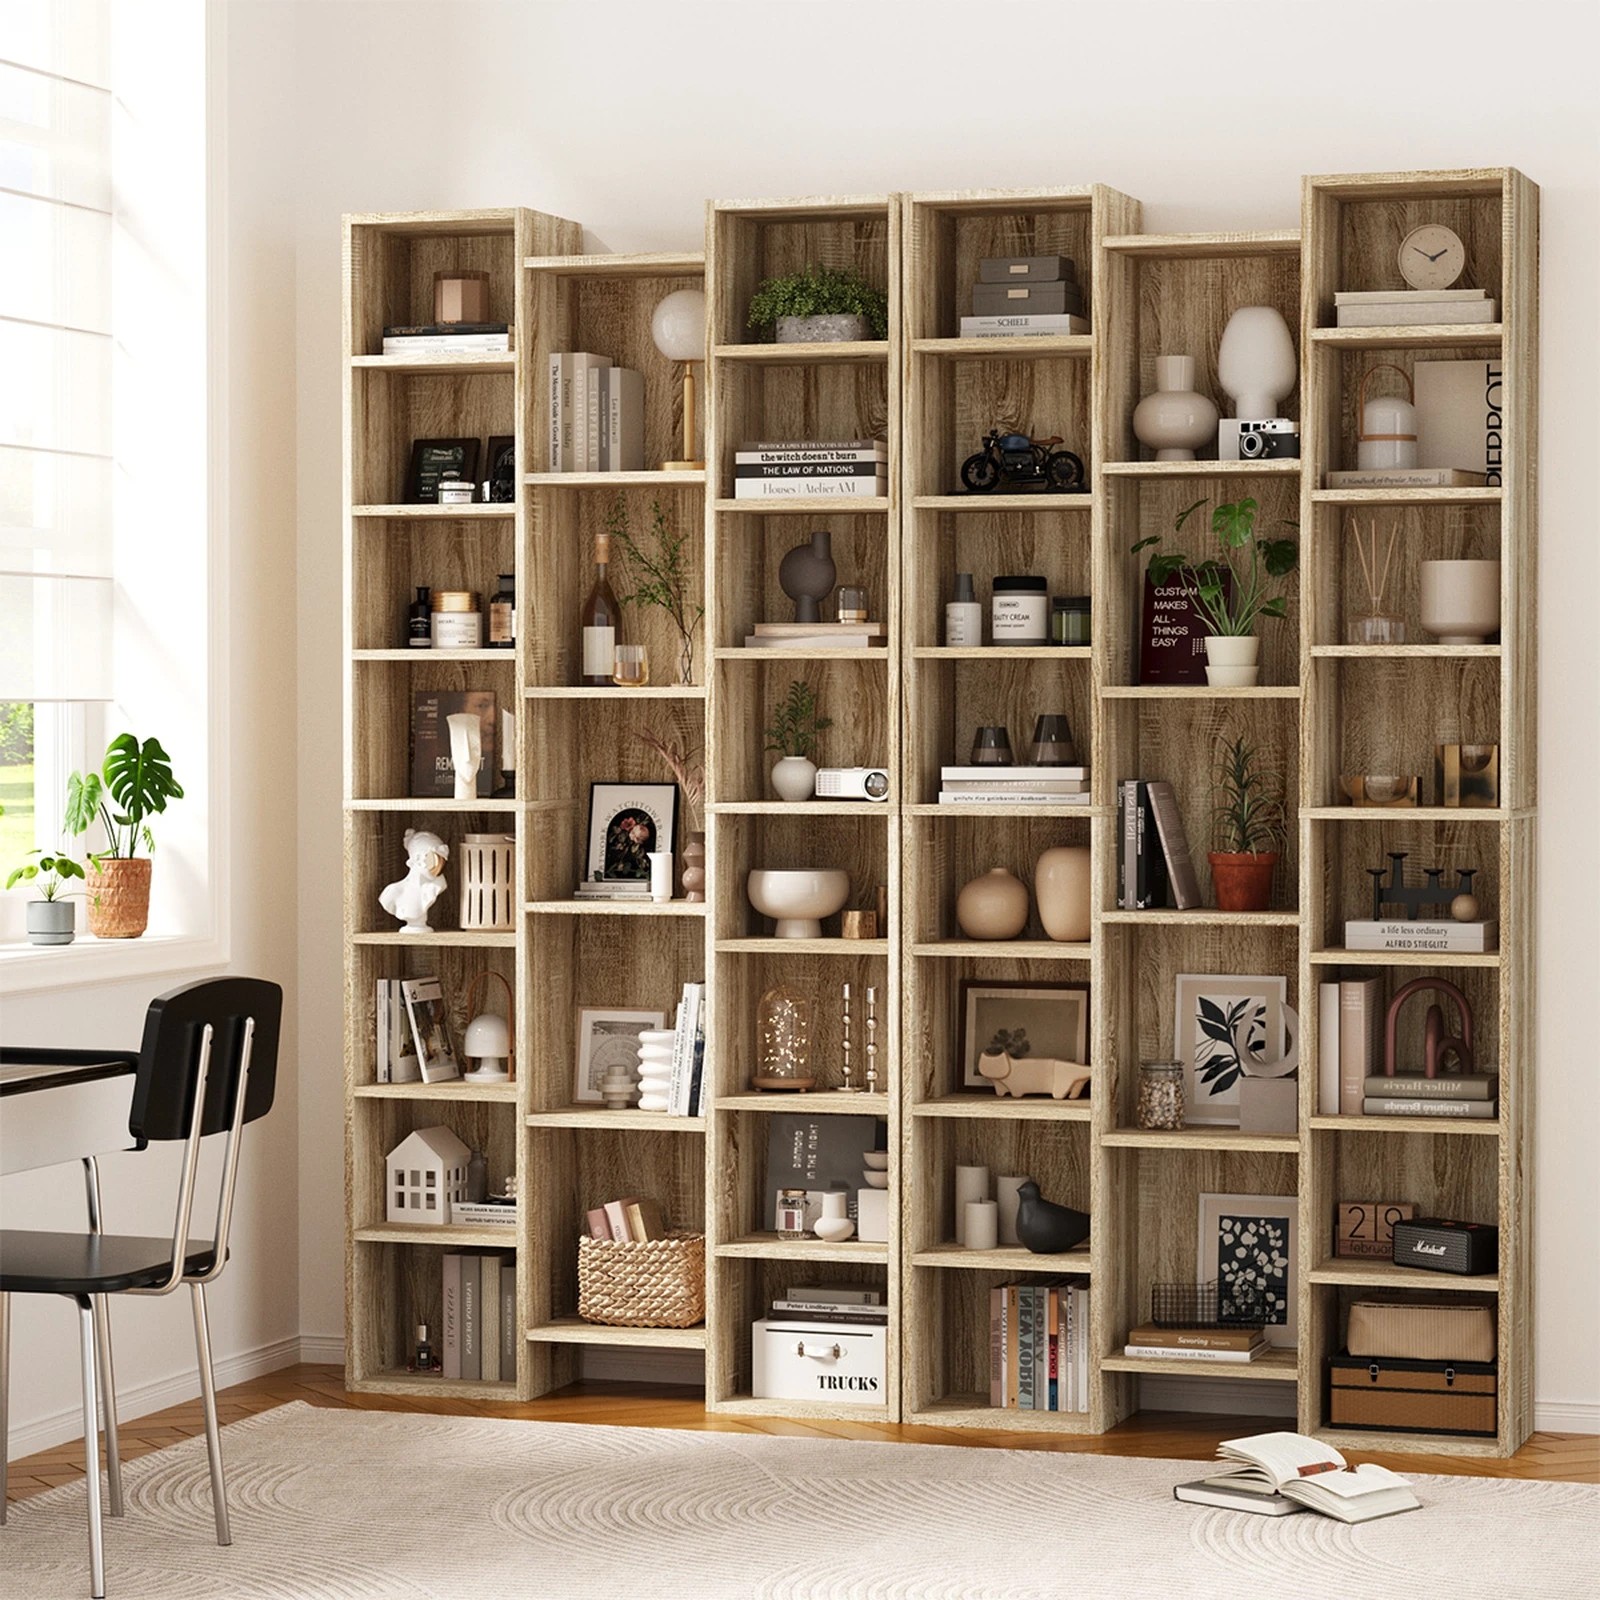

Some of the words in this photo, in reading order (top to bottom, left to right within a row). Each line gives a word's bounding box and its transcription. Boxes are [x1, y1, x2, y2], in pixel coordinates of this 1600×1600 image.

[997, 318, 1030, 327] SCHIELE
[761, 453, 775, 461] the
[776, 452, 800, 461] witch
[802, 451, 834, 460] doesn't
[836, 451, 857, 460] burn
[762, 466, 780, 475] THE
[782, 466, 801, 474] LAW
[802, 466, 814, 474] OF
[816, 465, 854, 474] NATIONS
[763, 483, 796, 494] Houses
[802, 482, 835, 494] Atelier
[839, 482, 856, 493] AM
[1153, 601, 1188, 610] MAKES
[1152, 615, 1170, 624] ALL
[1152, 626, 1189, 636] THINGS
[1151, 638, 1178, 647] EASY
[1387, 926, 1399, 934] life
[1401, 926, 1414, 935] less
[1416, 926, 1448, 936] ordinary
[1385, 940, 1412, 948] ALFRED
[1414, 940, 1448, 949] STIEGLITZ
[1412, 1240, 1446, 1256] Marshall
[805, 1304, 838, 1312] Lindbergh
[1177, 1336, 1208, 1346] Savoring
[817, 1375, 878, 1391] TRUCKS
